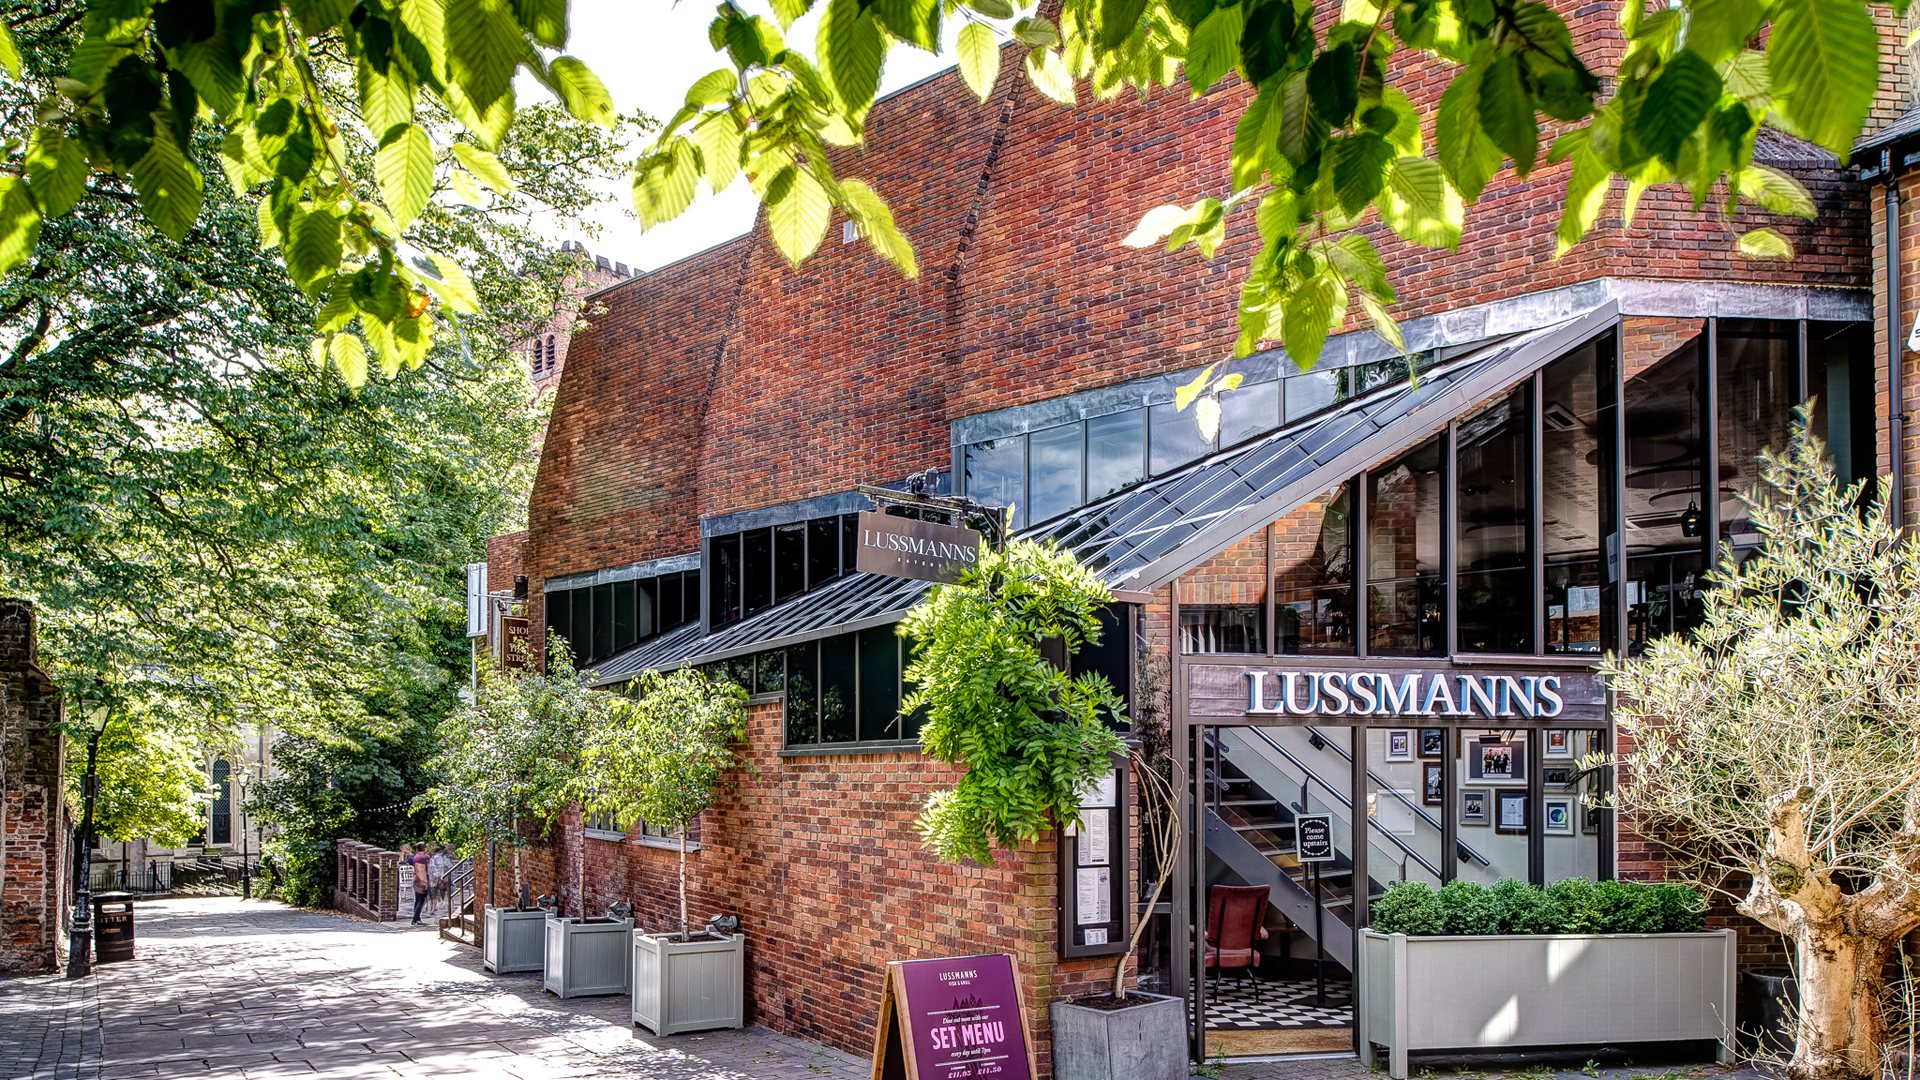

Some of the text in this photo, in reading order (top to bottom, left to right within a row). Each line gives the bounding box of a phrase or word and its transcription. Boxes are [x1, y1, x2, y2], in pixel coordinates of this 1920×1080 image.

[863, 529, 976, 563] LUSSMANNS
[1246, 671, 1564, 718] LUSSMANNS
[1302, 840, 1329, 848] upstairs
[939, 969, 978, 981] LUSSMANNS
[930, 1021, 1005, 1050] SET MENU
